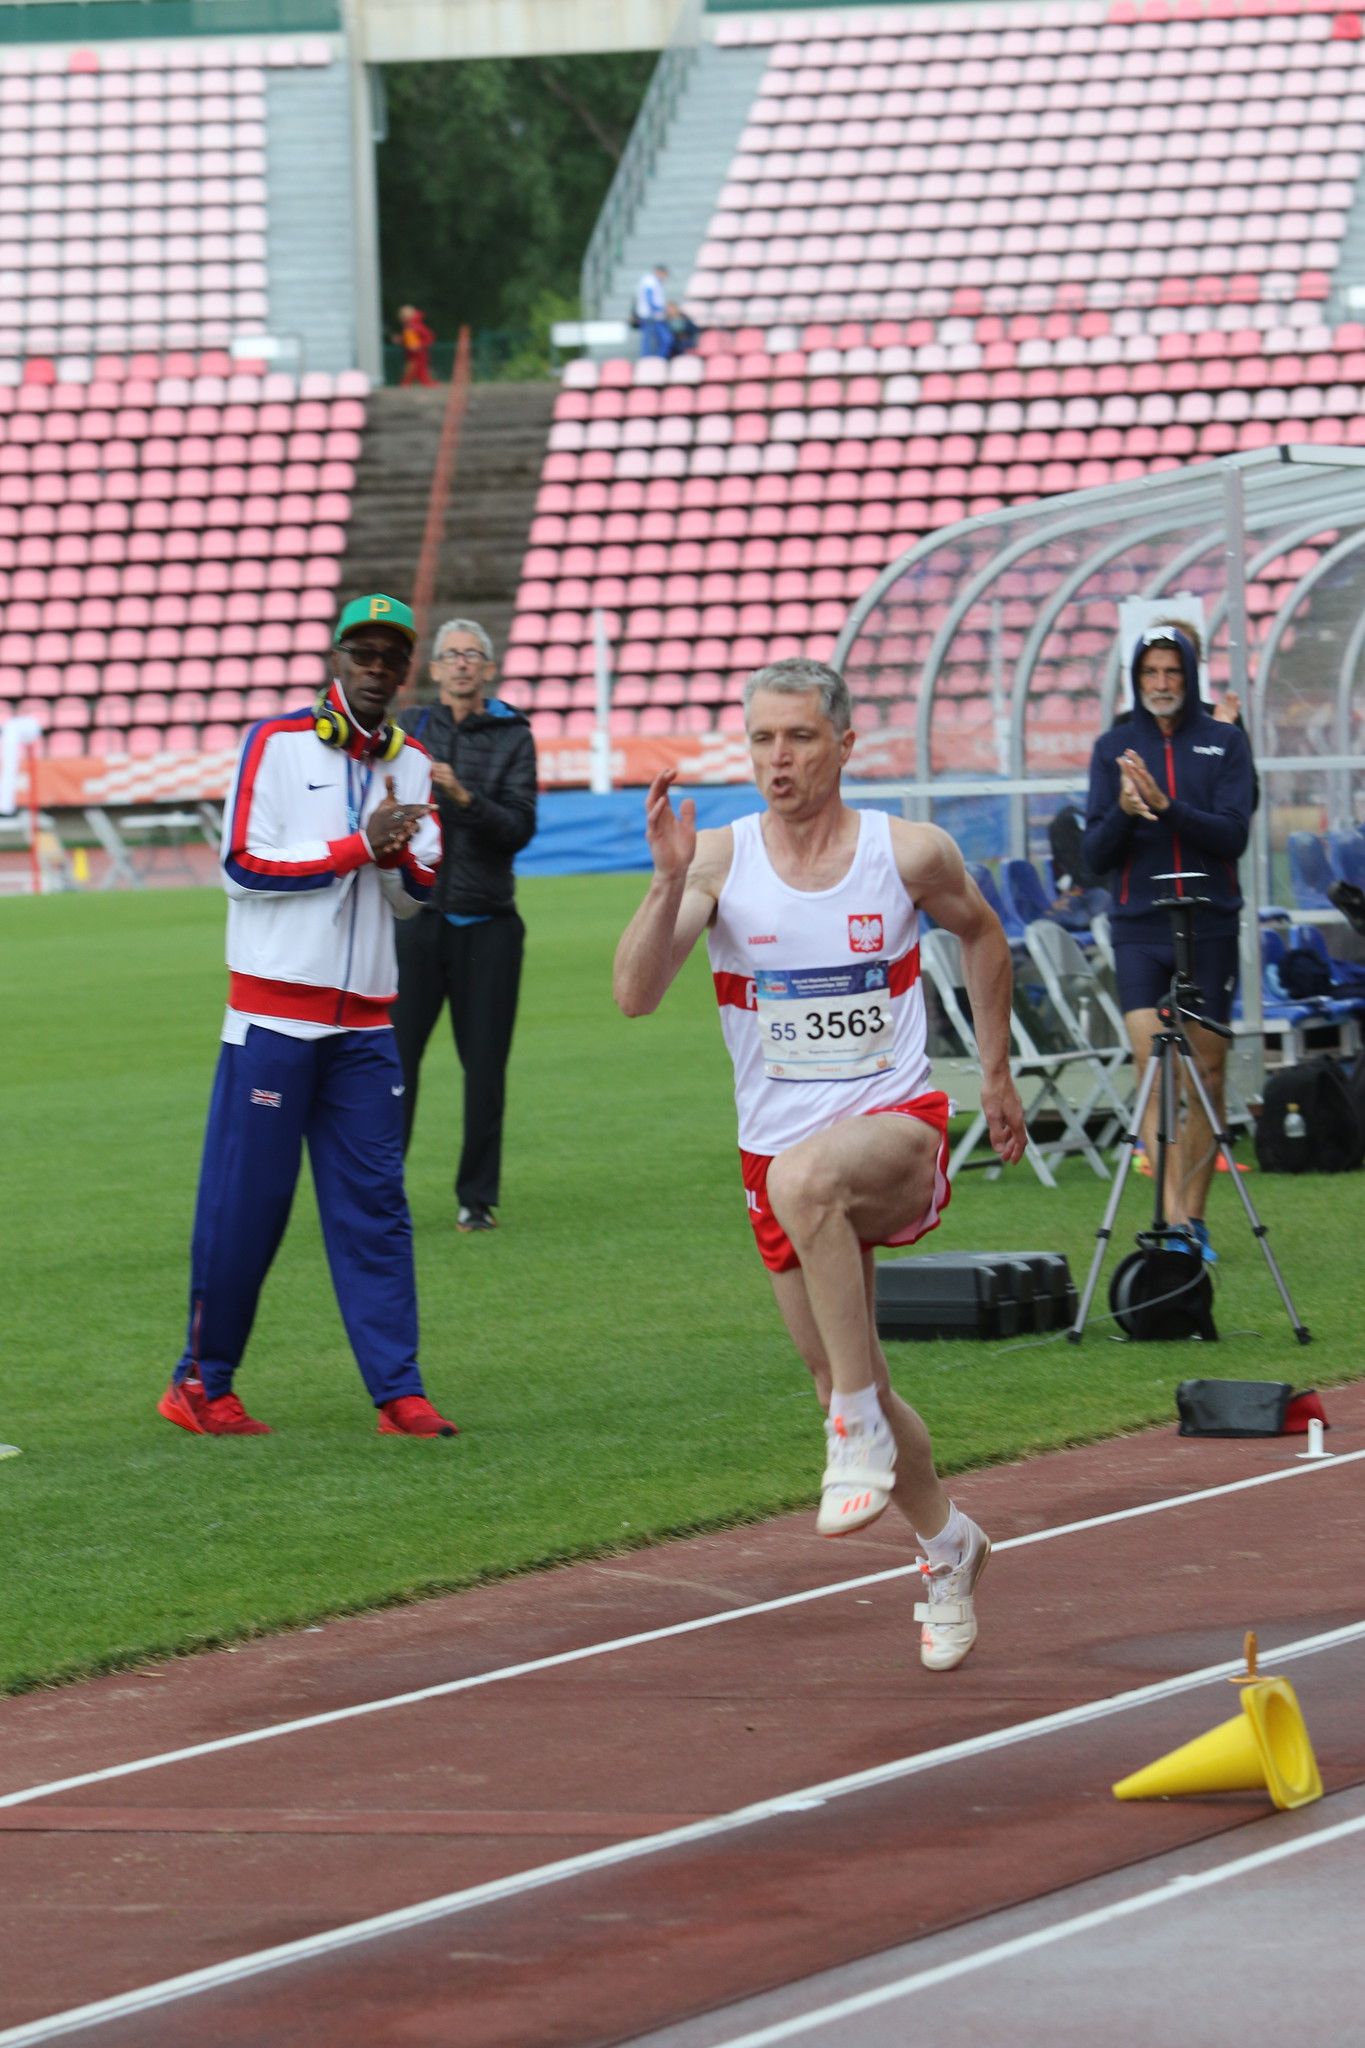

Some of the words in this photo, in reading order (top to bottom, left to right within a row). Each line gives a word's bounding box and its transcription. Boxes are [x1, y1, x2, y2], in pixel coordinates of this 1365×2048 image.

[369, 598, 391, 620] P
[771, 1022, 796, 1041] 55
[806, 1005, 885, 1040] 3563
